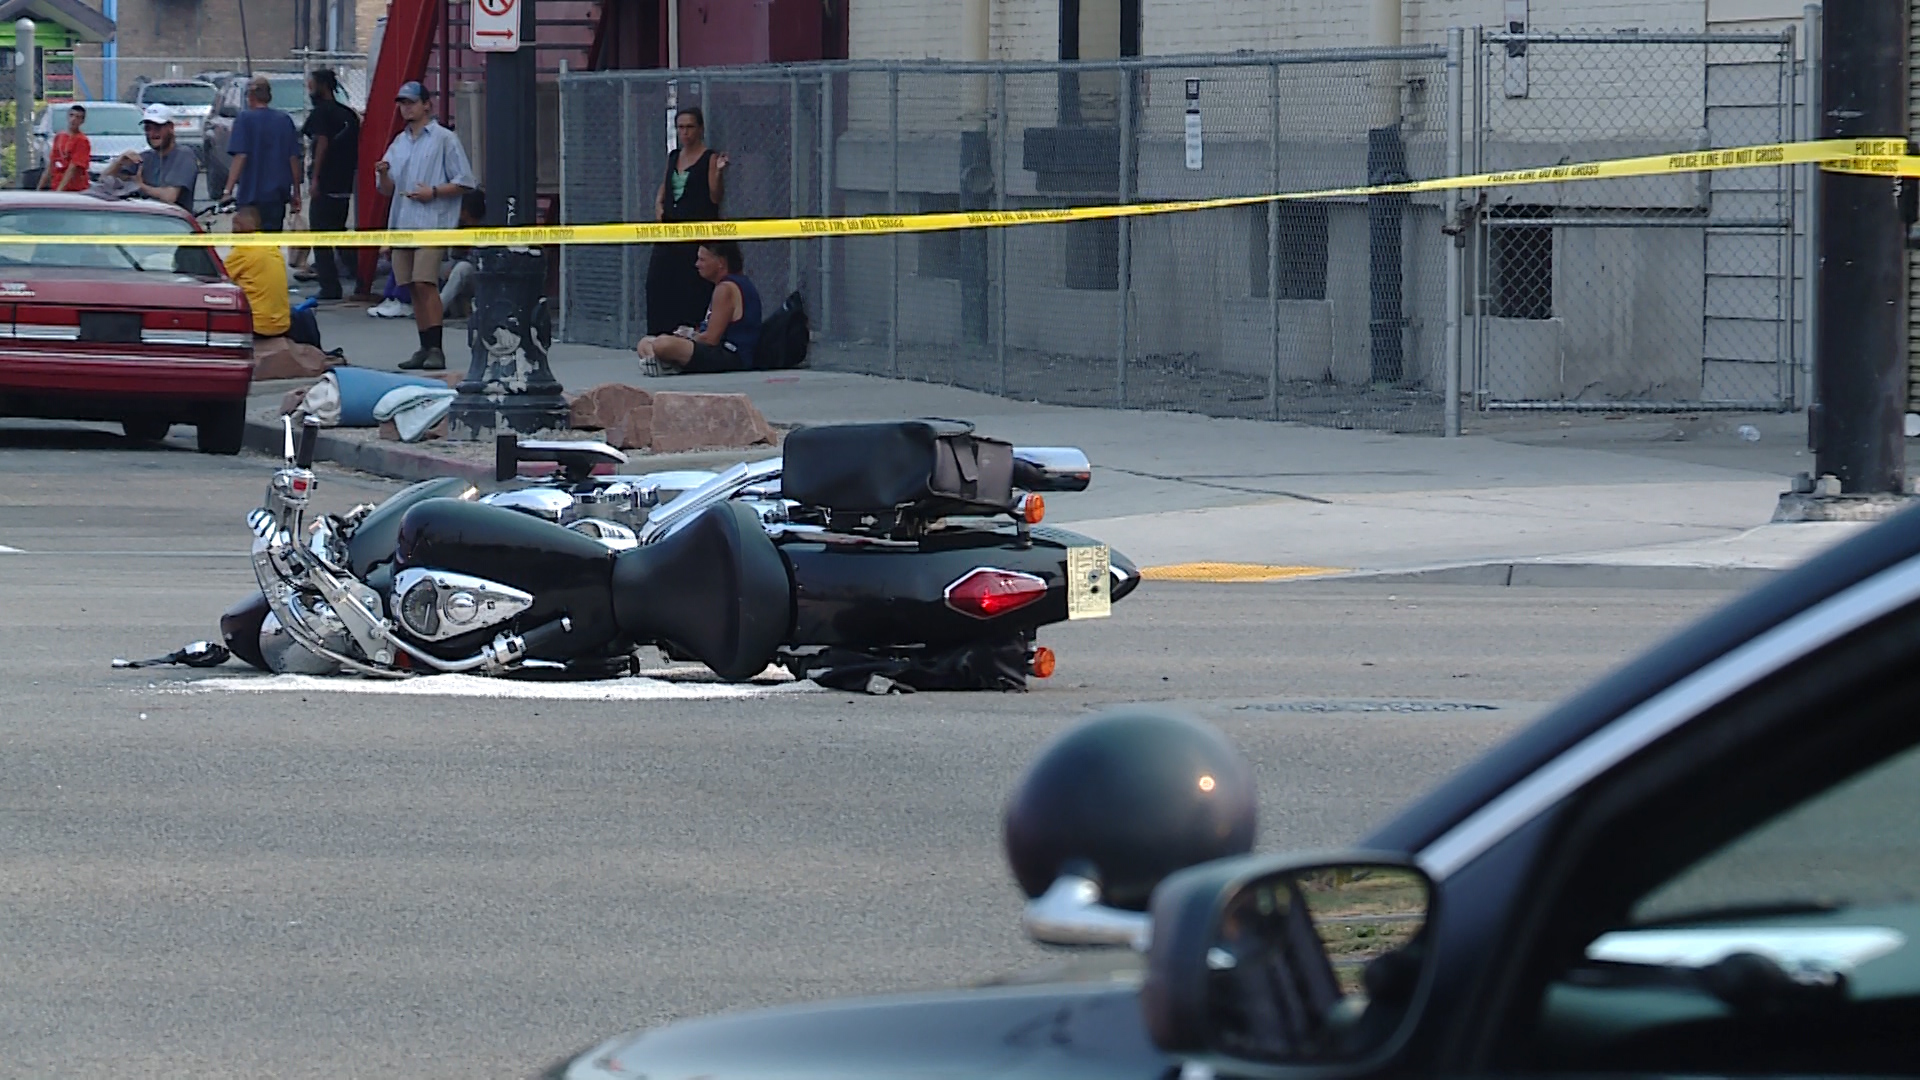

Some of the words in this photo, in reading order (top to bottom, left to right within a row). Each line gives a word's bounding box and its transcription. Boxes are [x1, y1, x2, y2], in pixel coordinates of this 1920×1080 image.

[1855, 142, 1885, 155] POLICE
[1669, 155, 1697, 168] POLICE
[1701, 153, 1720, 166] LINE
[1722, 151, 1734, 165] DO
[1736, 149, 1753, 163] NOT
[1755, 147, 1784, 162] CROSS
[1570, 164, 1600, 176] CROSS
[1853, 158, 1868, 169] NOT
[1871, 159, 1898, 171] CROSS
